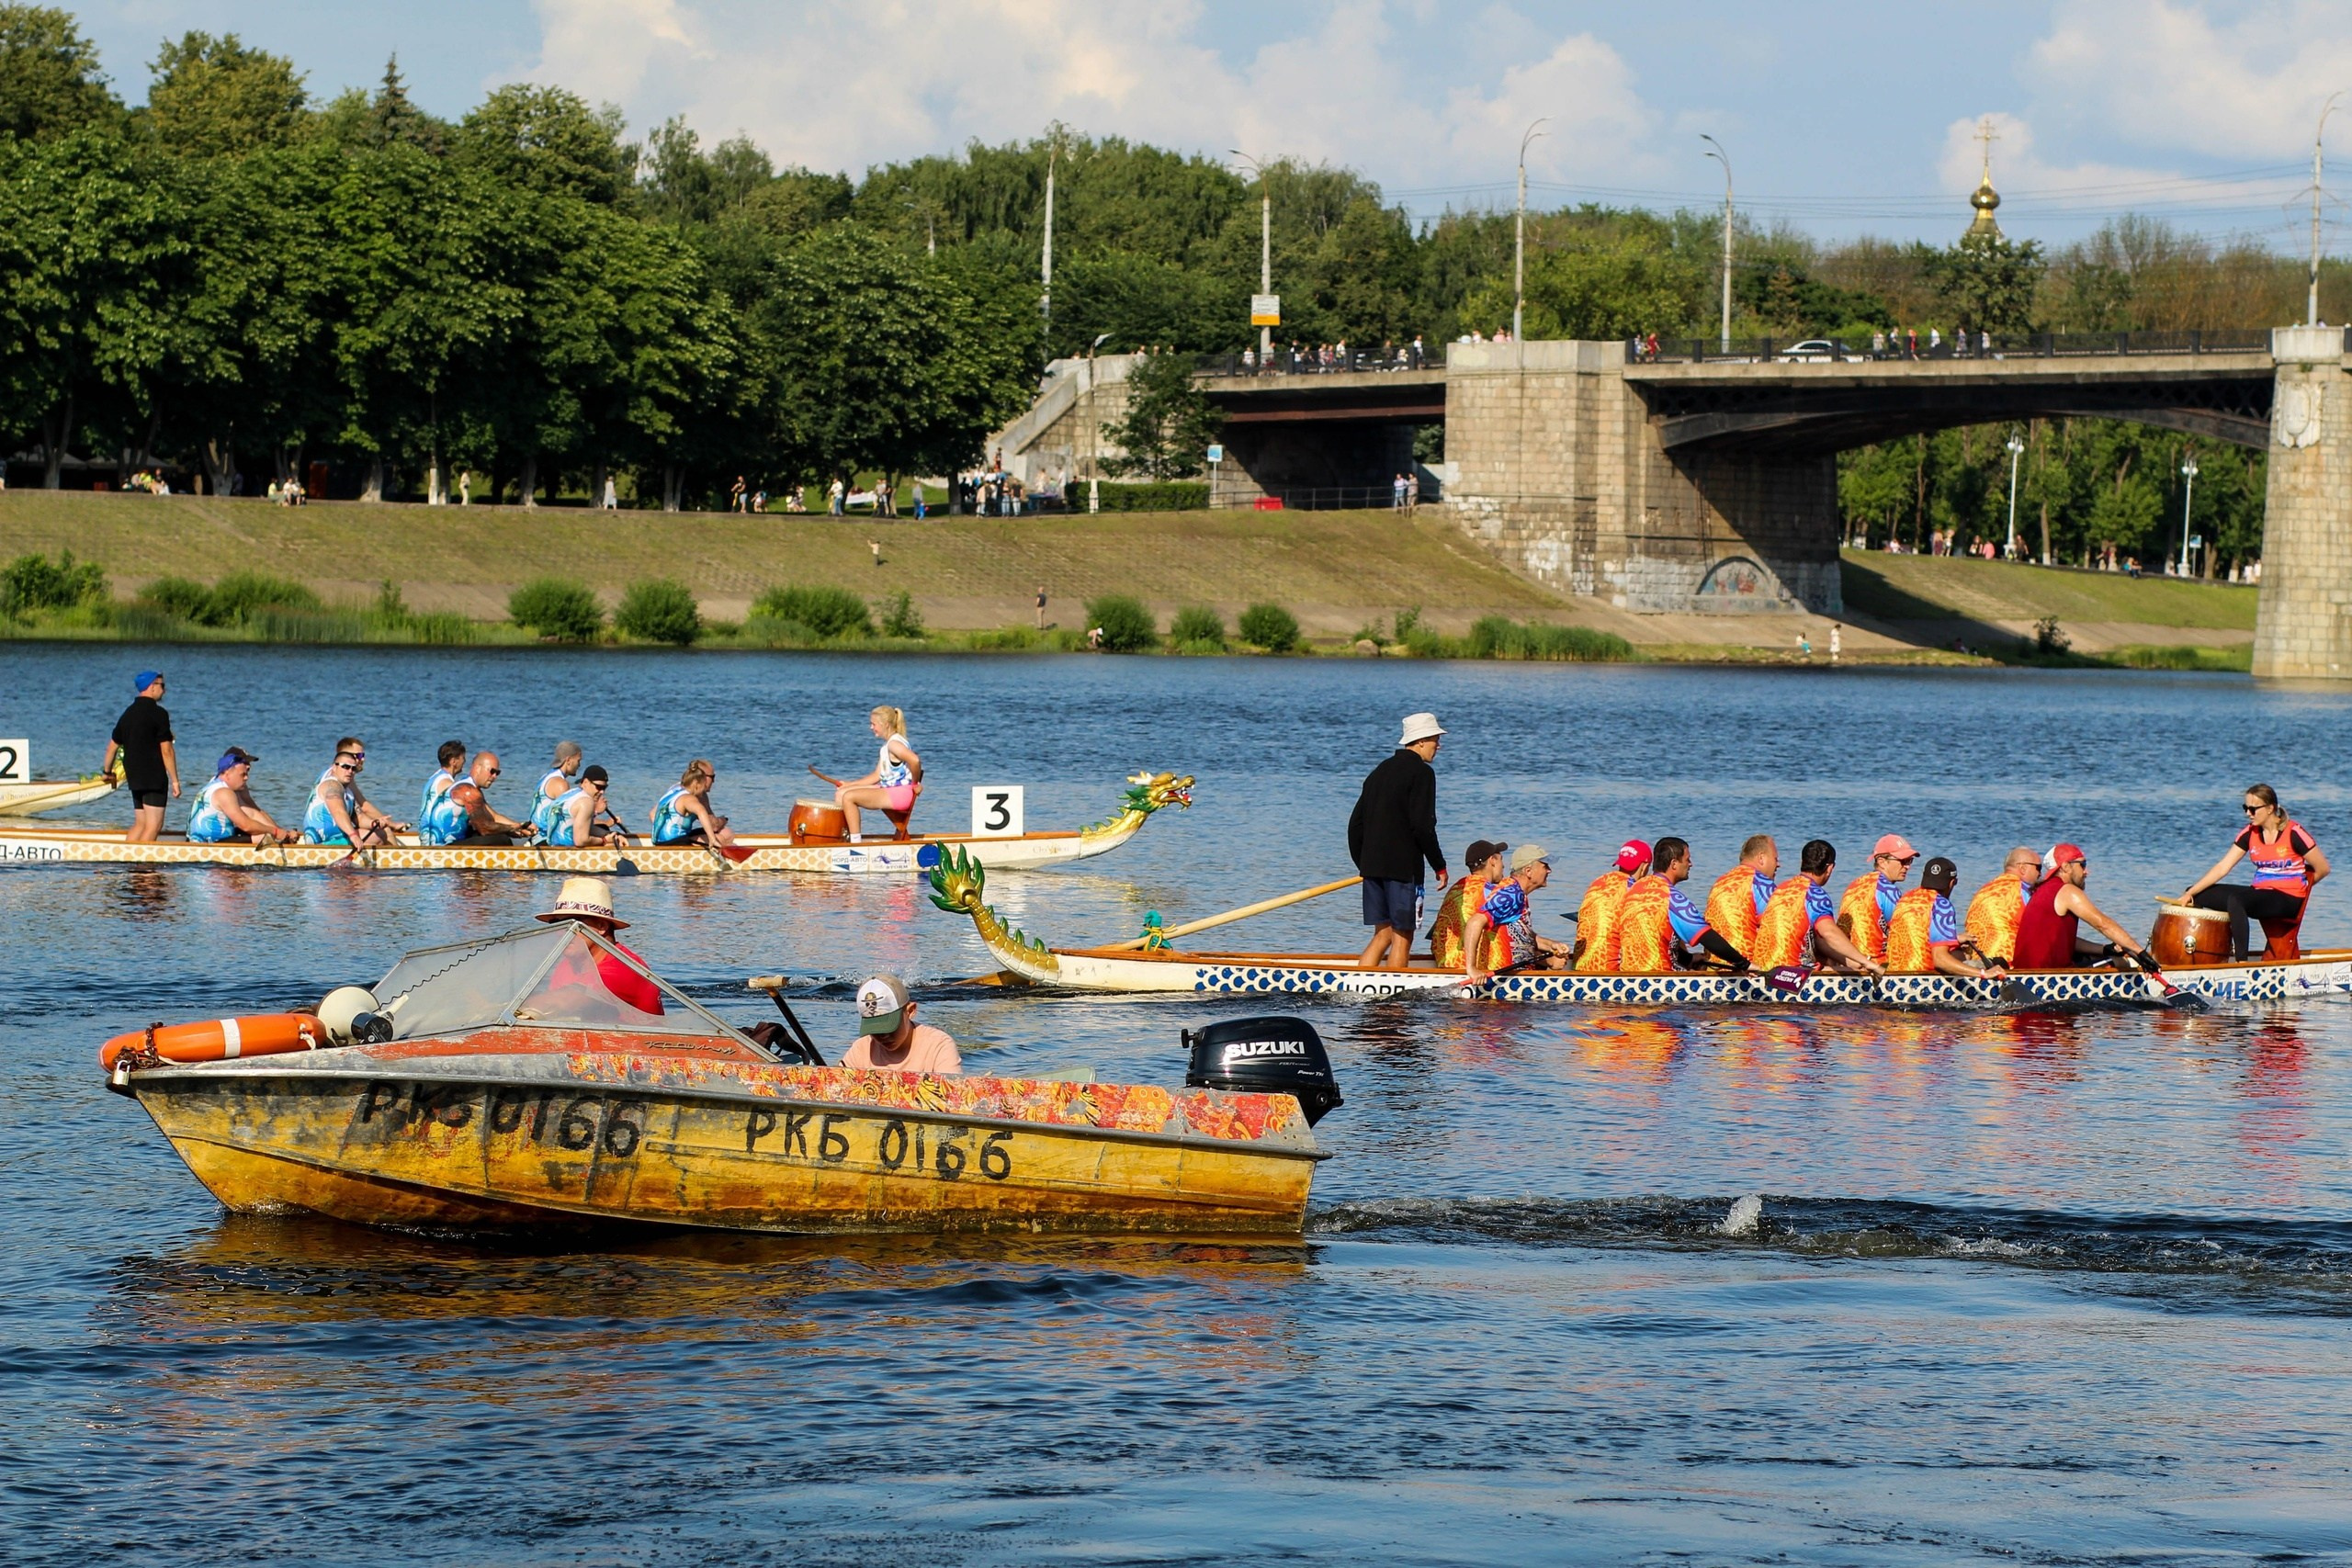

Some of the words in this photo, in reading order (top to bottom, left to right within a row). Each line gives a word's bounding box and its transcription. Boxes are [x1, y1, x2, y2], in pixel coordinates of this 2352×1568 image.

[0, 747, 18, 779] 2
[985, 793, 1011, 830] 3
[1224, 1041, 1306, 1057] SUZUKI
[746, 1106, 851, 1163] РКБ
[879, 1119, 1014, 1182] 0166
